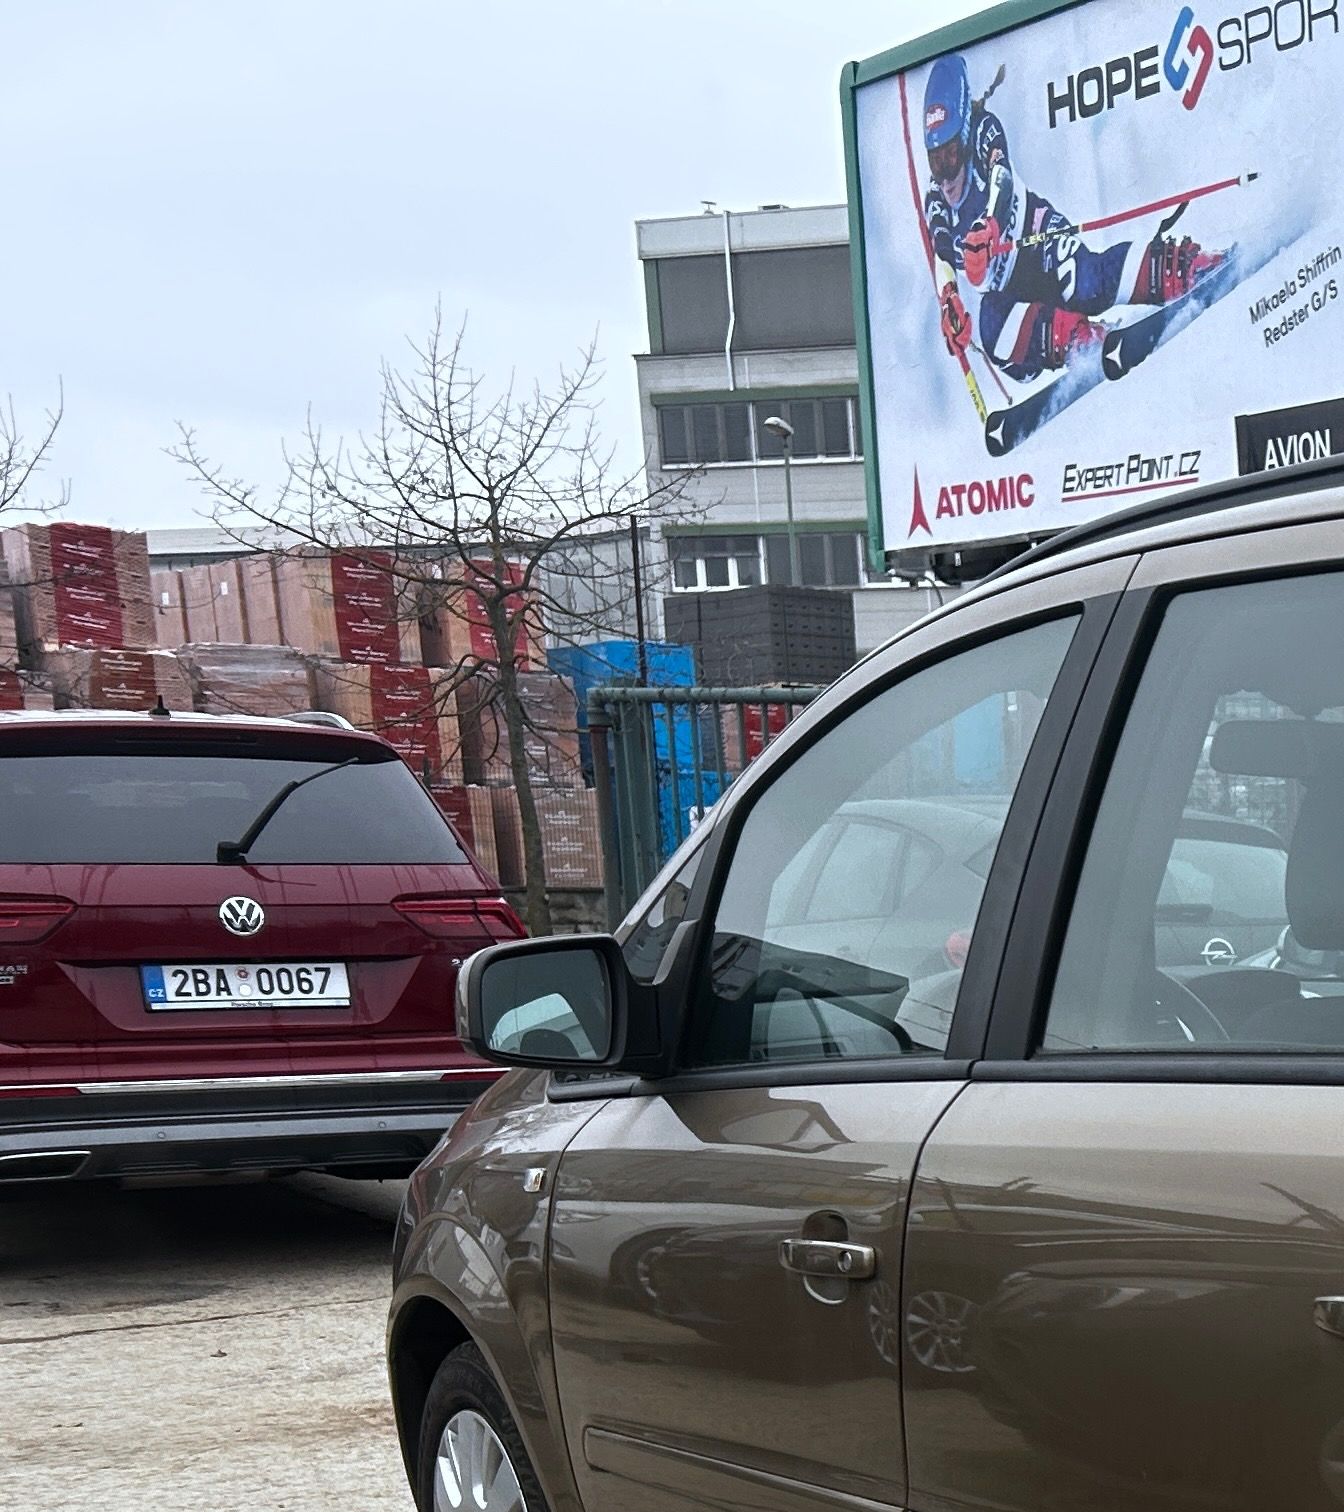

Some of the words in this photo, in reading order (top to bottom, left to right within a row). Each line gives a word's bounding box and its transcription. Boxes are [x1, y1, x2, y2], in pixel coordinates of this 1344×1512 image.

[1047, 44, 1161, 129] HOPE
[1249, 281, 1297, 325] Mikaela
[1297, 246, 1342, 288] Shiffrin
[1263, 304, 1309, 348] Redster
[1311, 279, 1338, 312] G/S
[1265, 428, 1332, 471] AVION
[936, 473, 1035, 520] ATOMIC
[148, 988, 165, 998] CZ
[171, 968, 232, 997] 2BA
[256, 966, 331, 995] 0067
